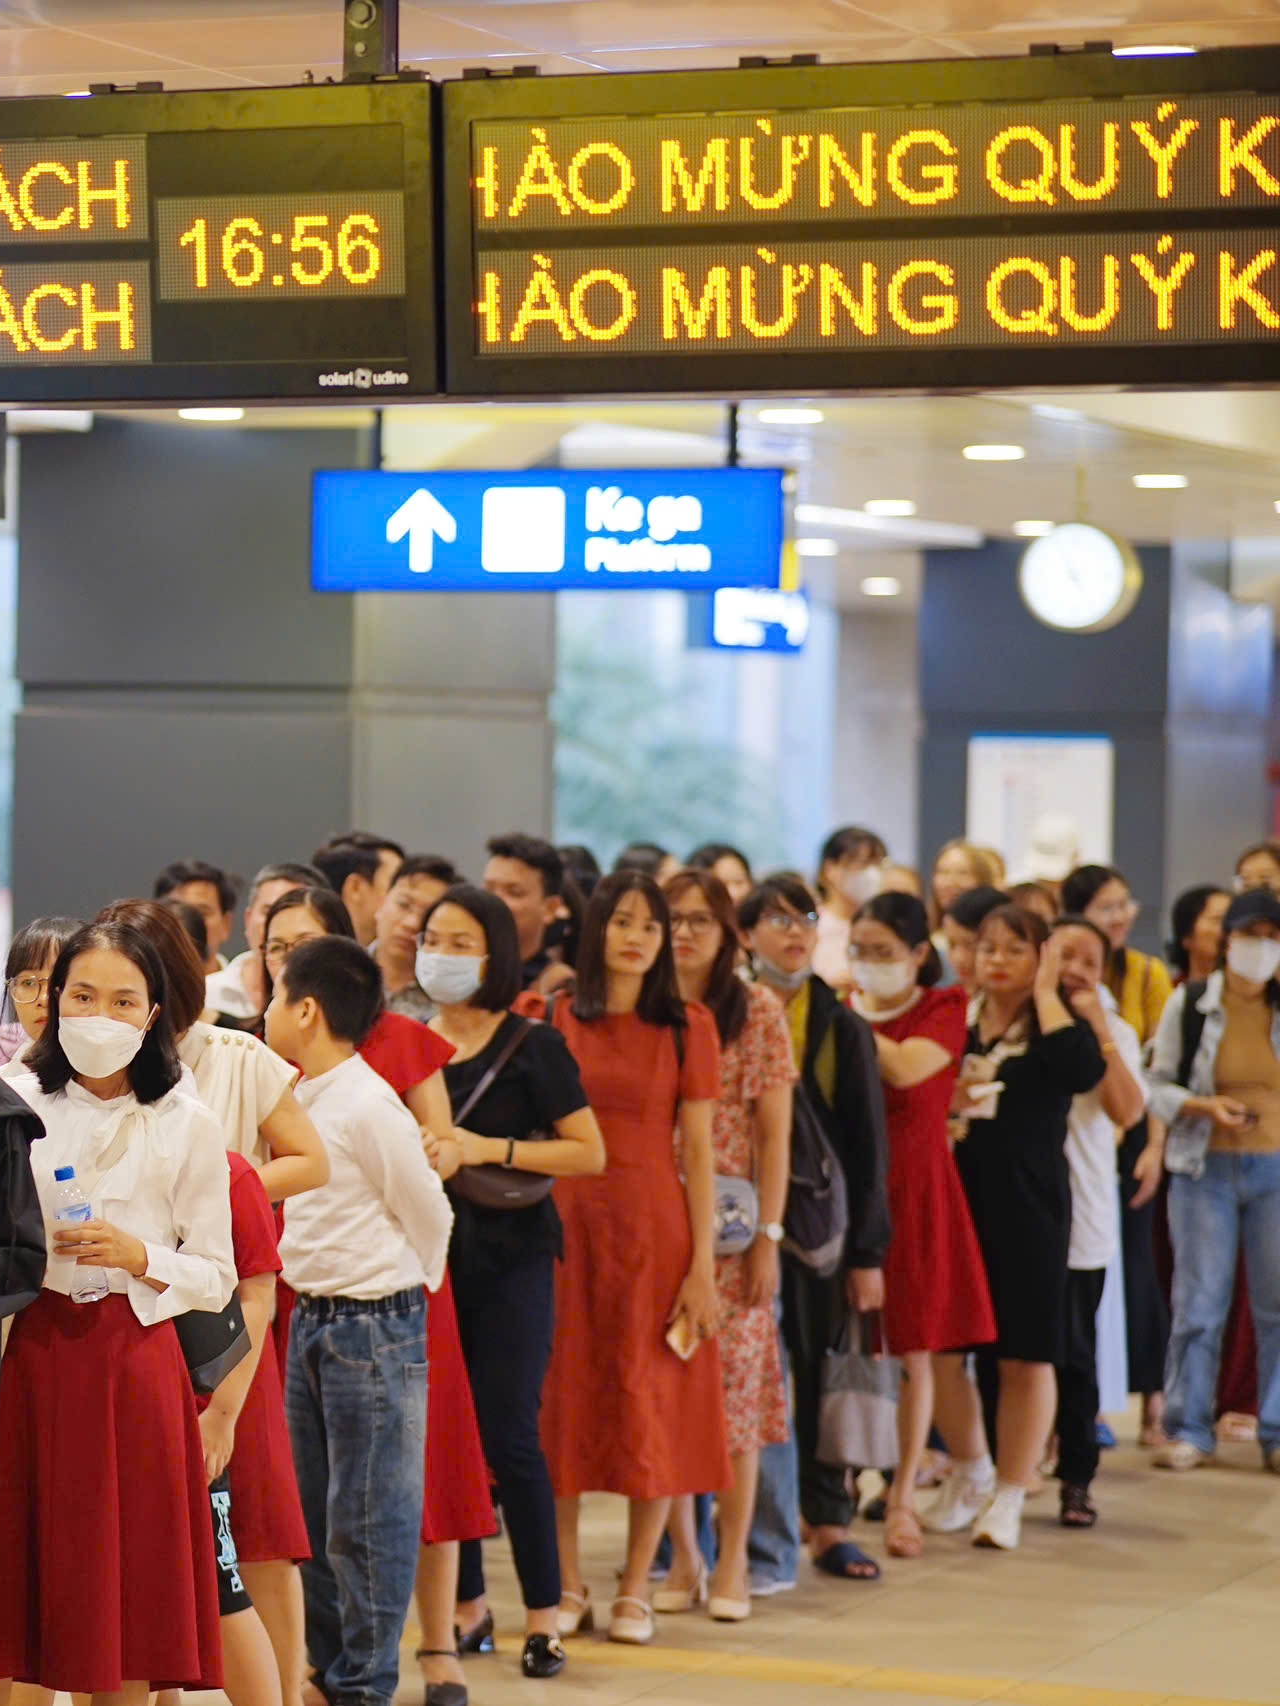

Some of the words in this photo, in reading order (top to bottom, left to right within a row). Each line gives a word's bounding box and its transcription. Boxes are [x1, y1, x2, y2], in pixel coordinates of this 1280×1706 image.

[661, 118, 959, 213] MỪNG
[985, 101, 1200, 206] QUÝ
[180, 214, 381, 288] 16:56
[662, 247, 959, 340] MỪNG
[986, 234, 1195, 337] QUÝ
